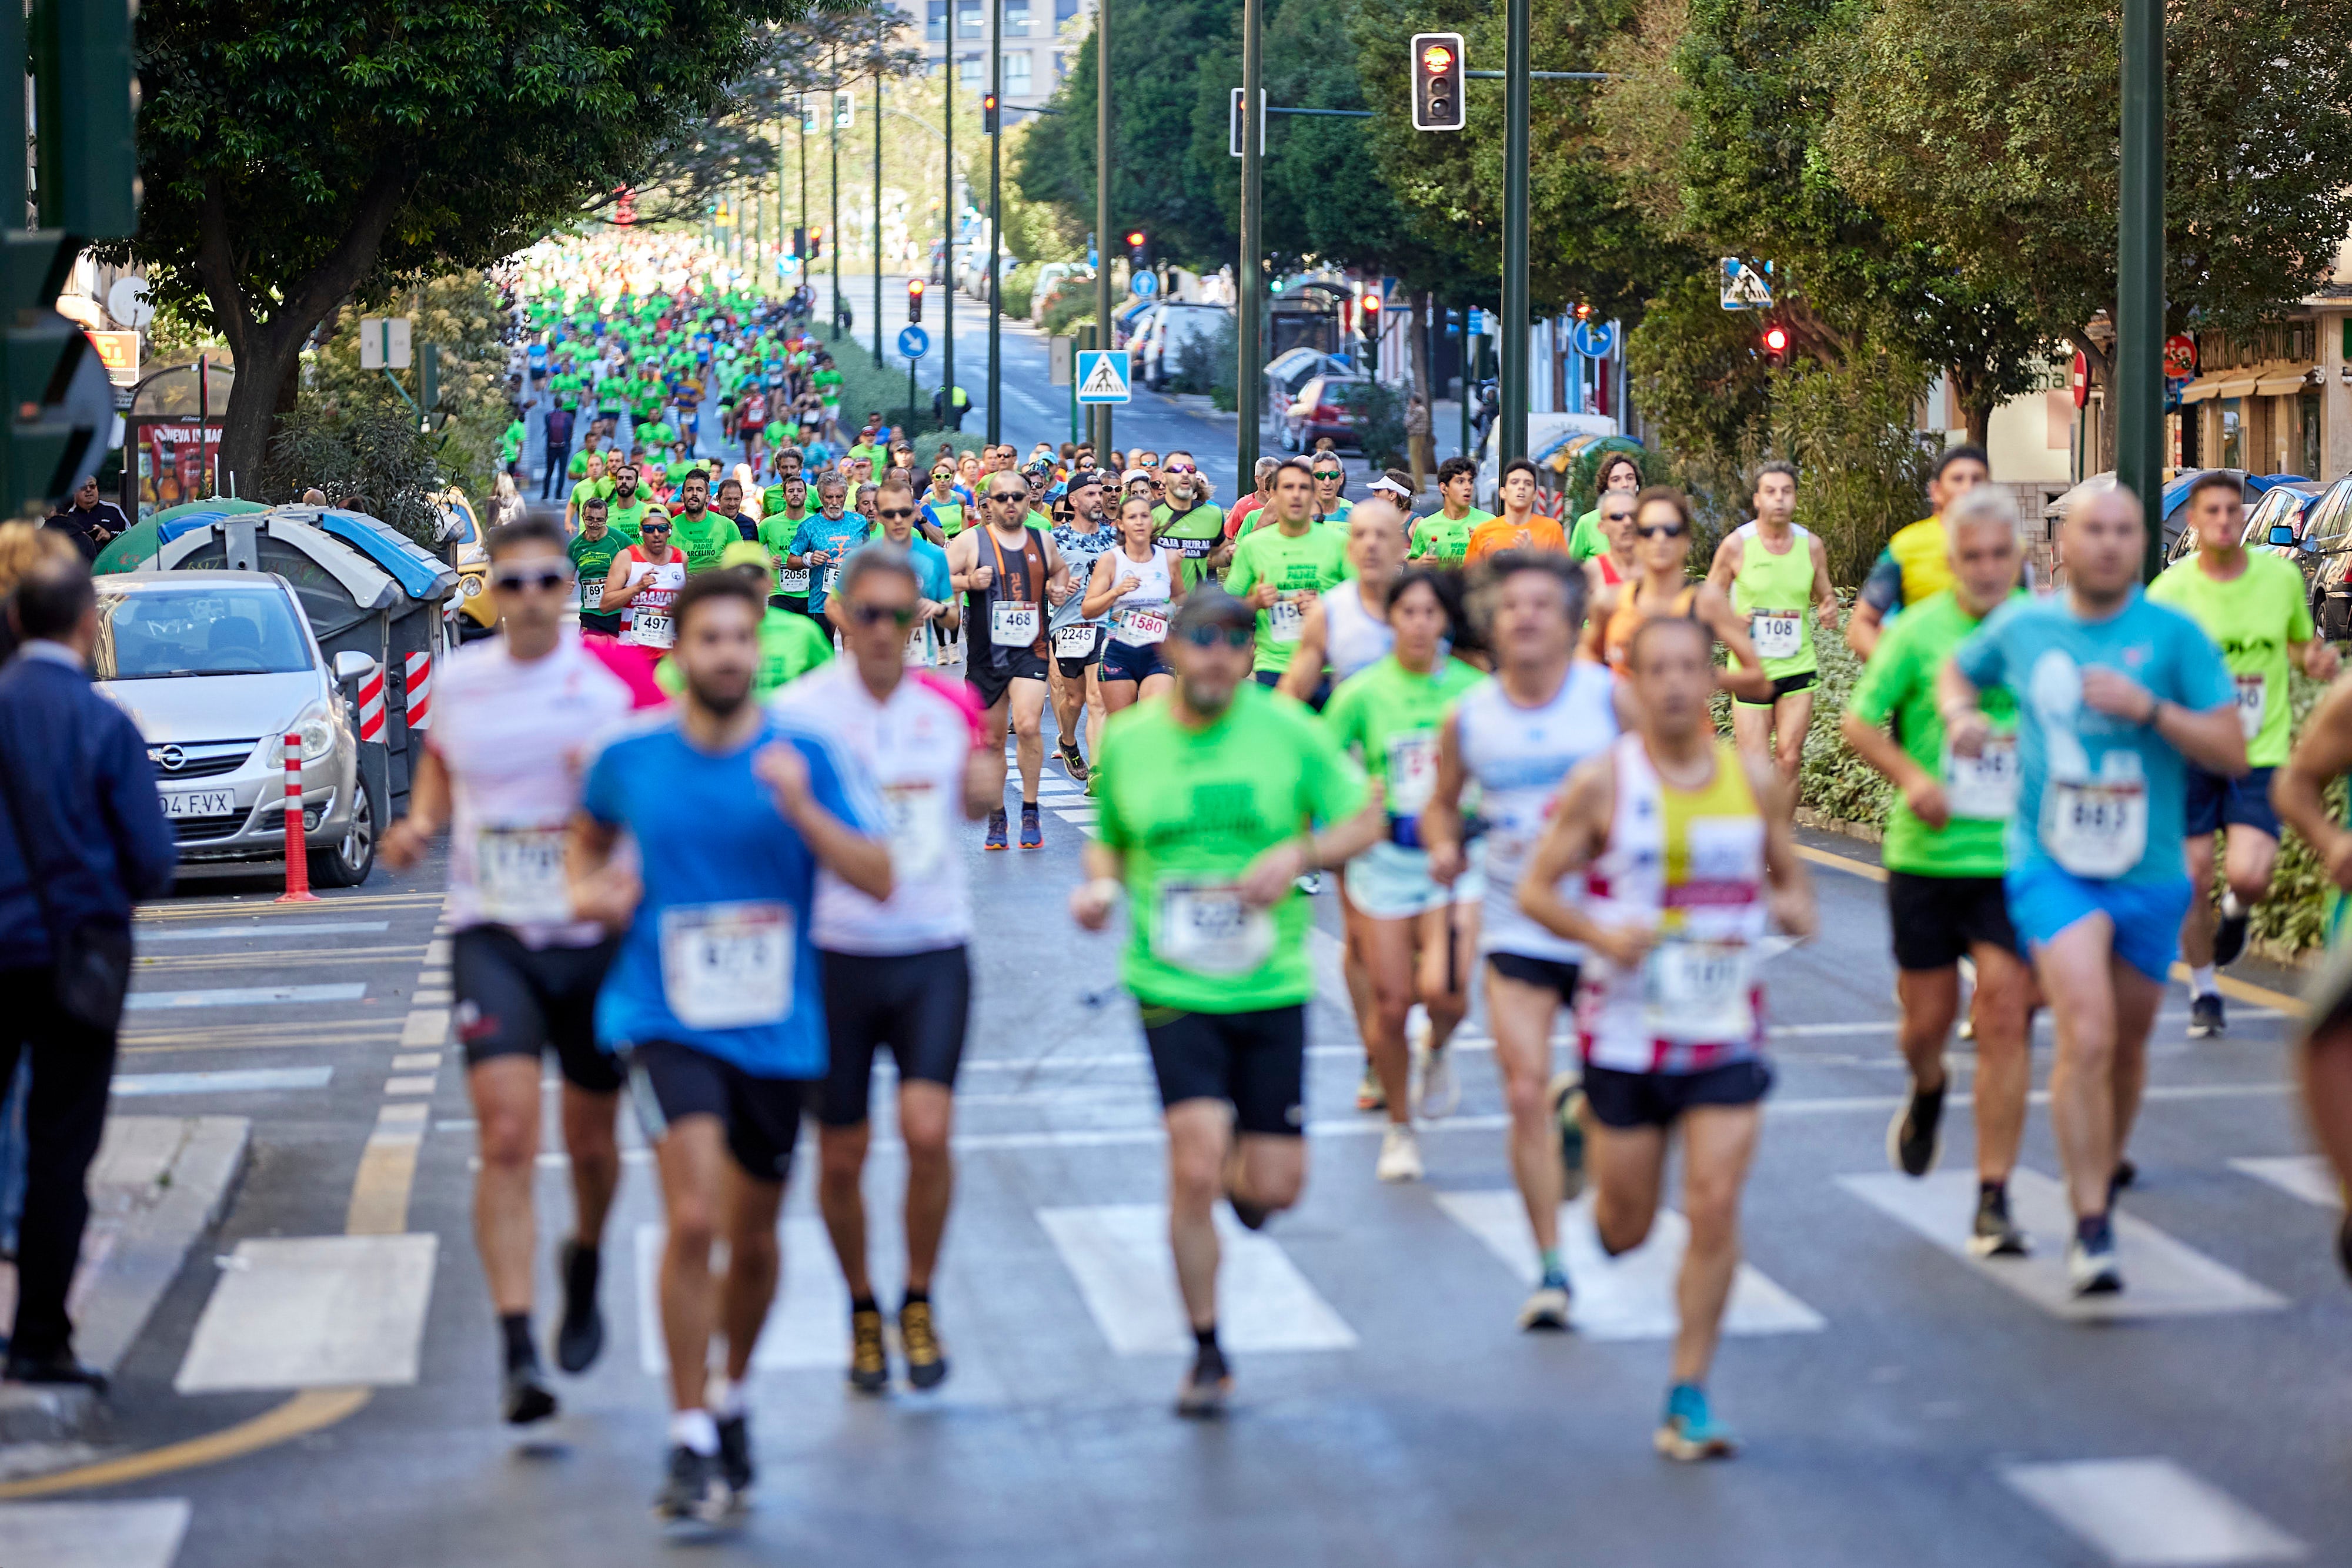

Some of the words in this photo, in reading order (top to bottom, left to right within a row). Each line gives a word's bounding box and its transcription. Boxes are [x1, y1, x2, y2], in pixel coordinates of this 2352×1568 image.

[153, 429, 191, 442] NUEVA
[1157, 537, 1180, 548] CAJA
[1181, 540, 1210, 550] RURAL
[784, 570, 807, 579] 2058
[644, 616, 669, 630] 497
[1006, 612, 1031, 626] 468
[1130, 613, 1162, 633] 1580
[1061, 628, 1091, 640] 2245
[1765, 620, 1793, 636] 108
[189, 794, 226, 813] FVX
